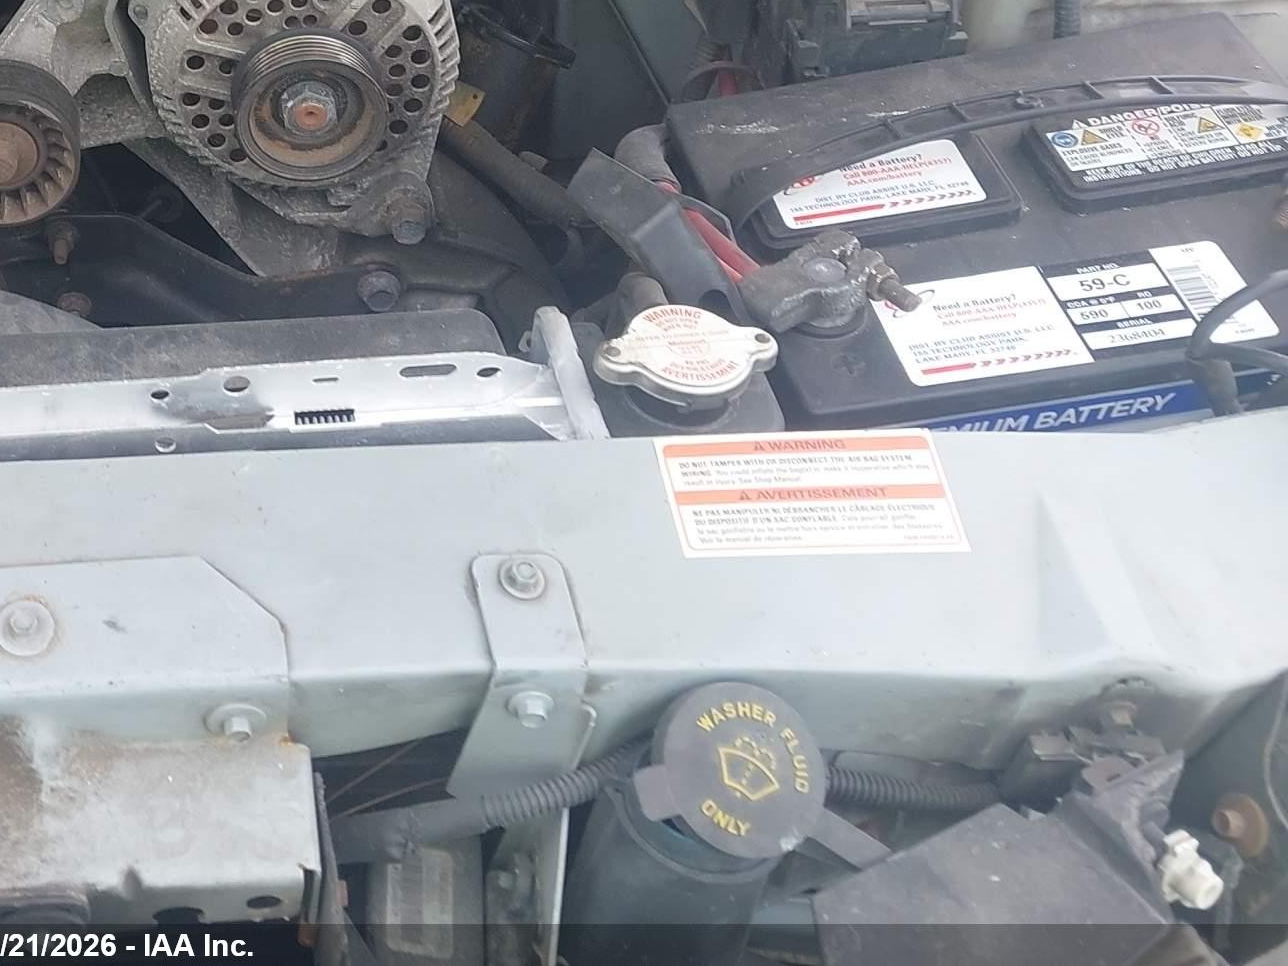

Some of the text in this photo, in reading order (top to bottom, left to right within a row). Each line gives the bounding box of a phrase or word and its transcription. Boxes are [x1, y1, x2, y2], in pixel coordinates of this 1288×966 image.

[1088, 103, 1213, 126] DANGER/POIS
[839, 161, 867, 173] Need
[878, 153, 923, 167] Battery?
[843, 170, 860, 180] Call
[846, 171, 923, 187] AAA.com/battery
[836, 192, 847, 201] BY
[848, 189, 870, 199] CLUB
[872, 185, 901, 195] ASSIST
[804, 198, 858, 211] TECHNOLOGY
[886, 192, 908, 201] LAKE
[1076, 265, 1100, 274] PART
[1079, 274, 1130, 292] 59-C
[932, 301, 961, 313] Need
[971, 293, 1016, 307] Battery?
[1066, 300, 1089, 309] CCA
[1080, 299, 1162, 321] 590 100
[642, 307, 702, 323] WARNING
[937, 311, 954, 320] Call
[1116, 317, 1154, 329] SERIAL
[663, 359, 739, 381] AVERTISSEMENT
[1034, 393, 1177, 429] BATTERY
[769, 439, 847, 451] WARNING
[679, 461, 690, 469] DO
[691, 460, 707, 468] NOT
[710, 459, 742, 467] TAMPER
[742, 458, 765, 466] WITH
[778, 455, 828, 465] DISCONNECT
[830, 455, 846, 463] THE
[863, 454, 879, 462] BAG
[880, 453, 912, 462] SYSTEM
[756, 488, 889, 501] AVERTISSEMENT
[722, 507, 769, 516] MANIPULER
[696, 702, 809, 794] WASHER FLUID
[700, 799, 751, 836] ONLY
